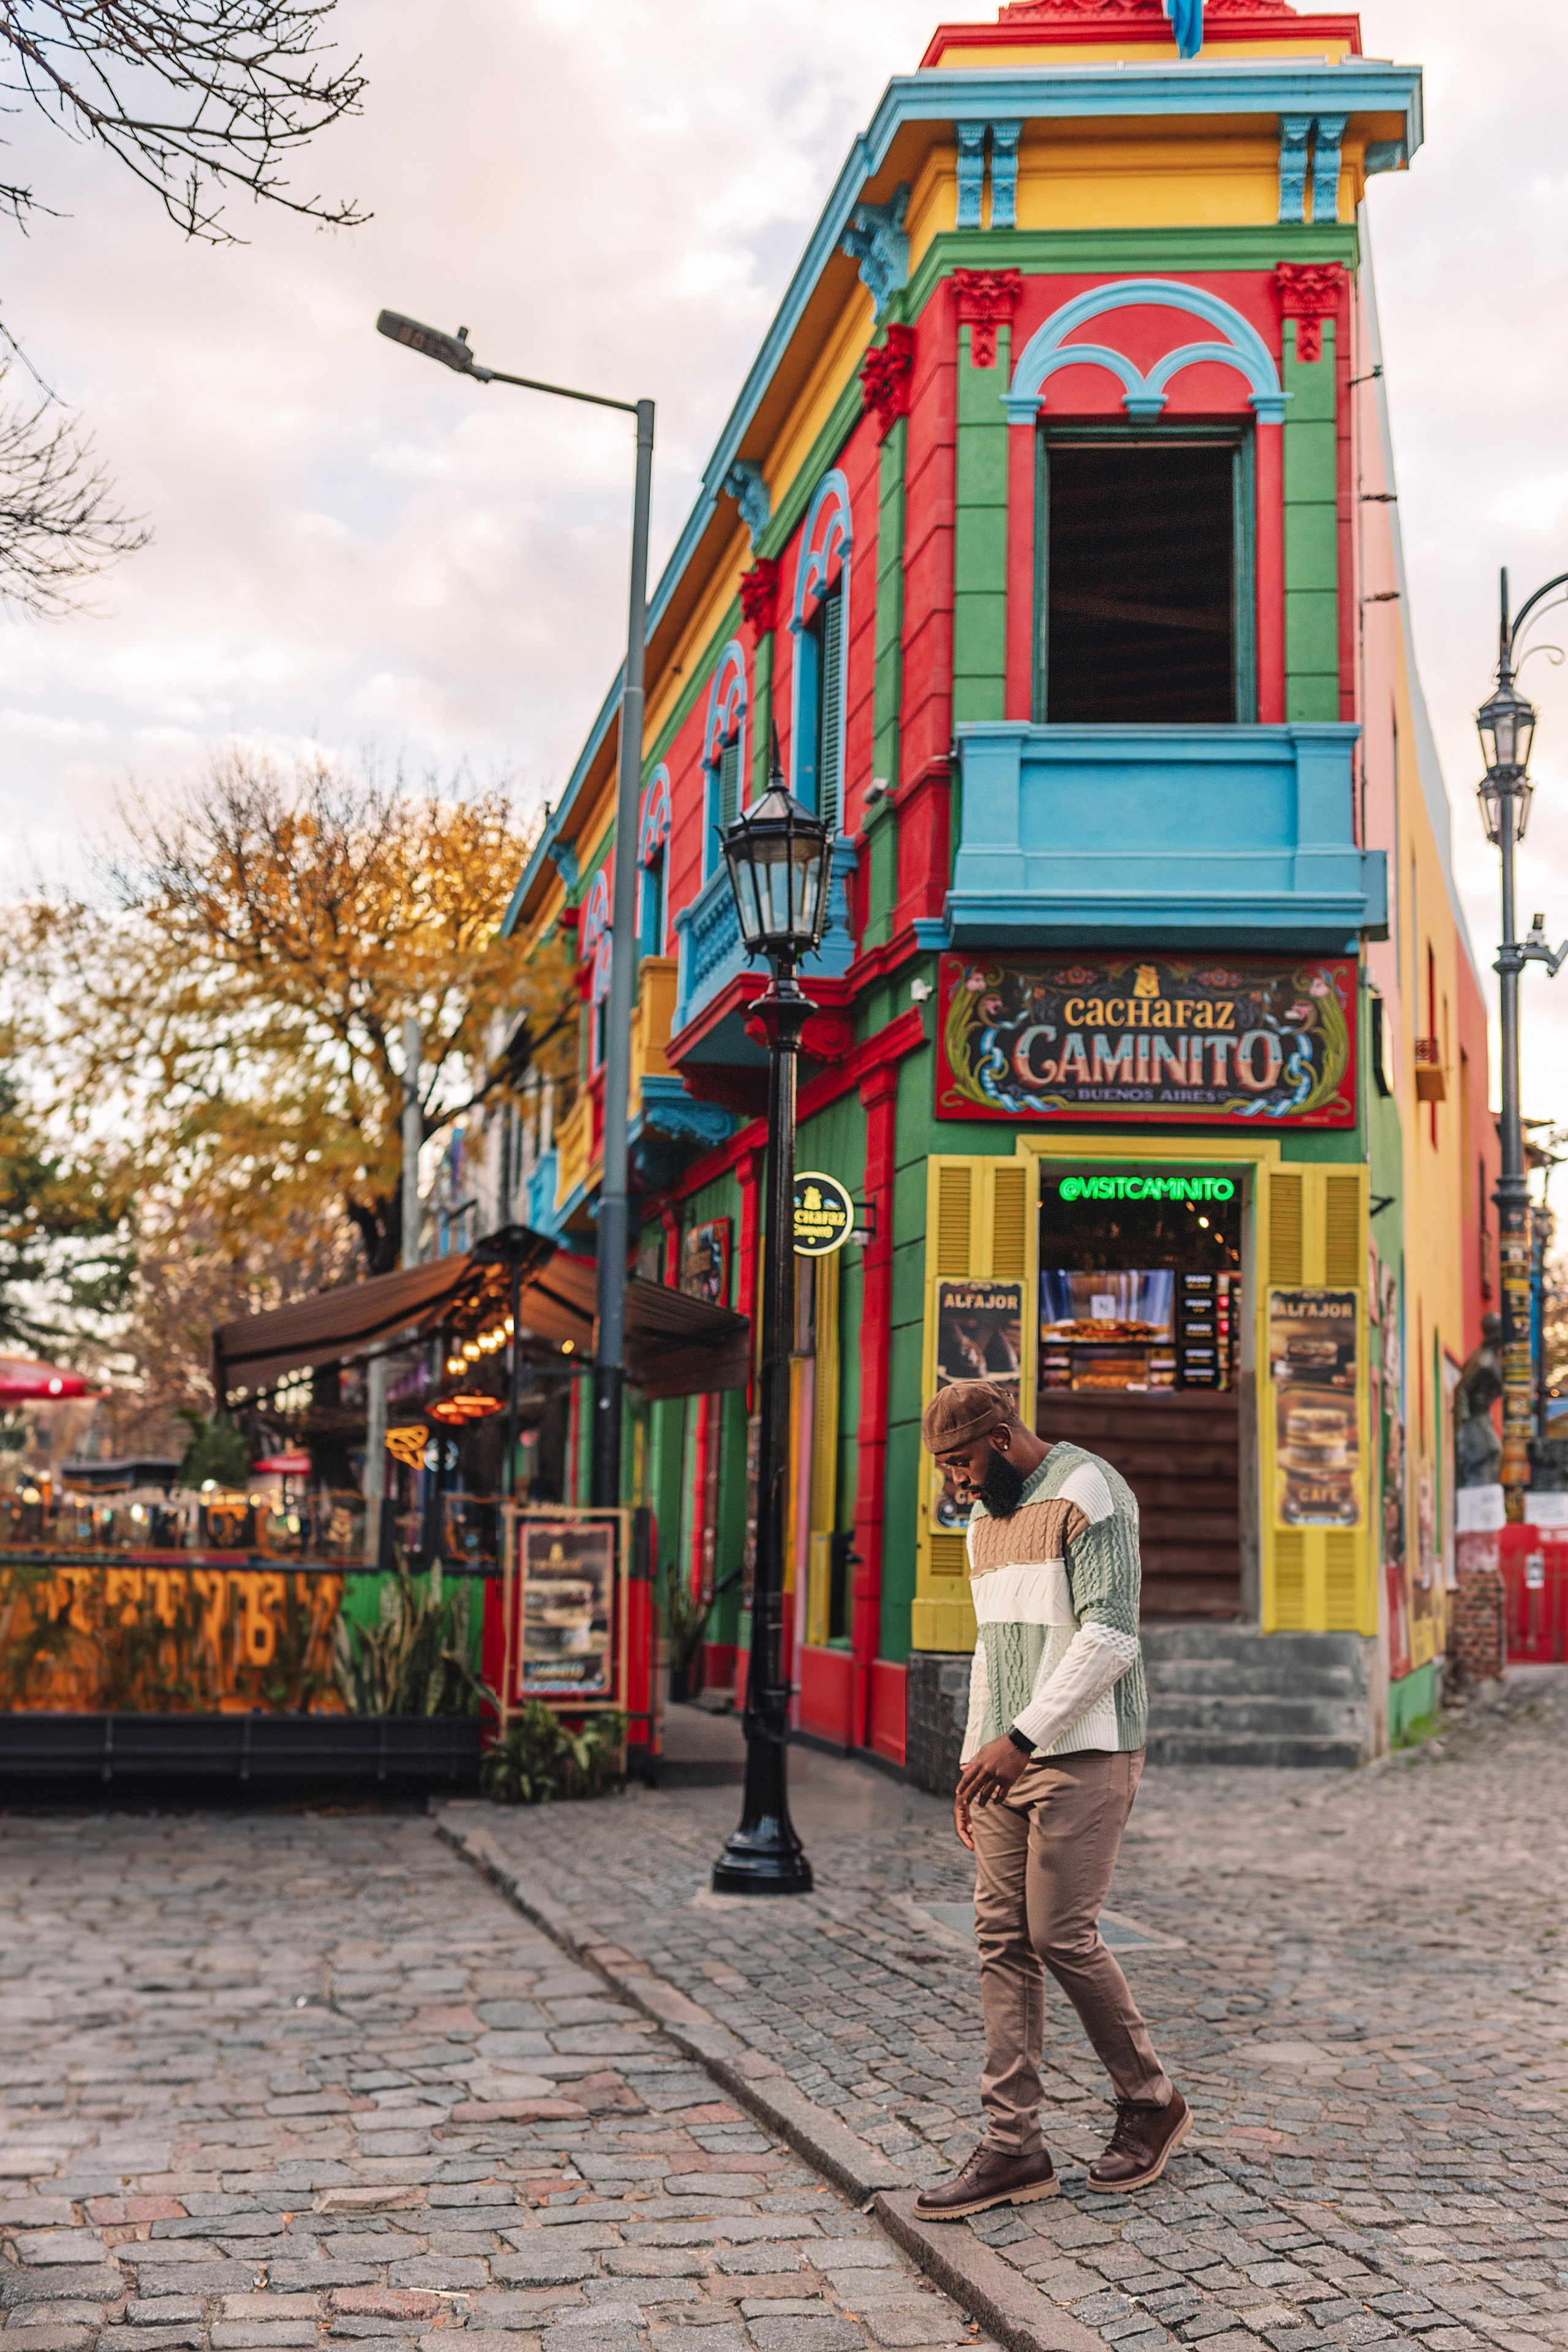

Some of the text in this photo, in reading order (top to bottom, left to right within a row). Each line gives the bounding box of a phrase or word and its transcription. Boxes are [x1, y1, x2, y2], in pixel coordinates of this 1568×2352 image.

[1012, 1024, 1284, 1091] CAMINITO
[1077, 1087, 1216, 1102] BUENOS AIRES
[1059, 1176, 1235, 1202] @VISITCAMINITO
[943, 1292, 1019, 1310] ALFAJOR
[1276, 1302, 1353, 1318] ALFAJOR
